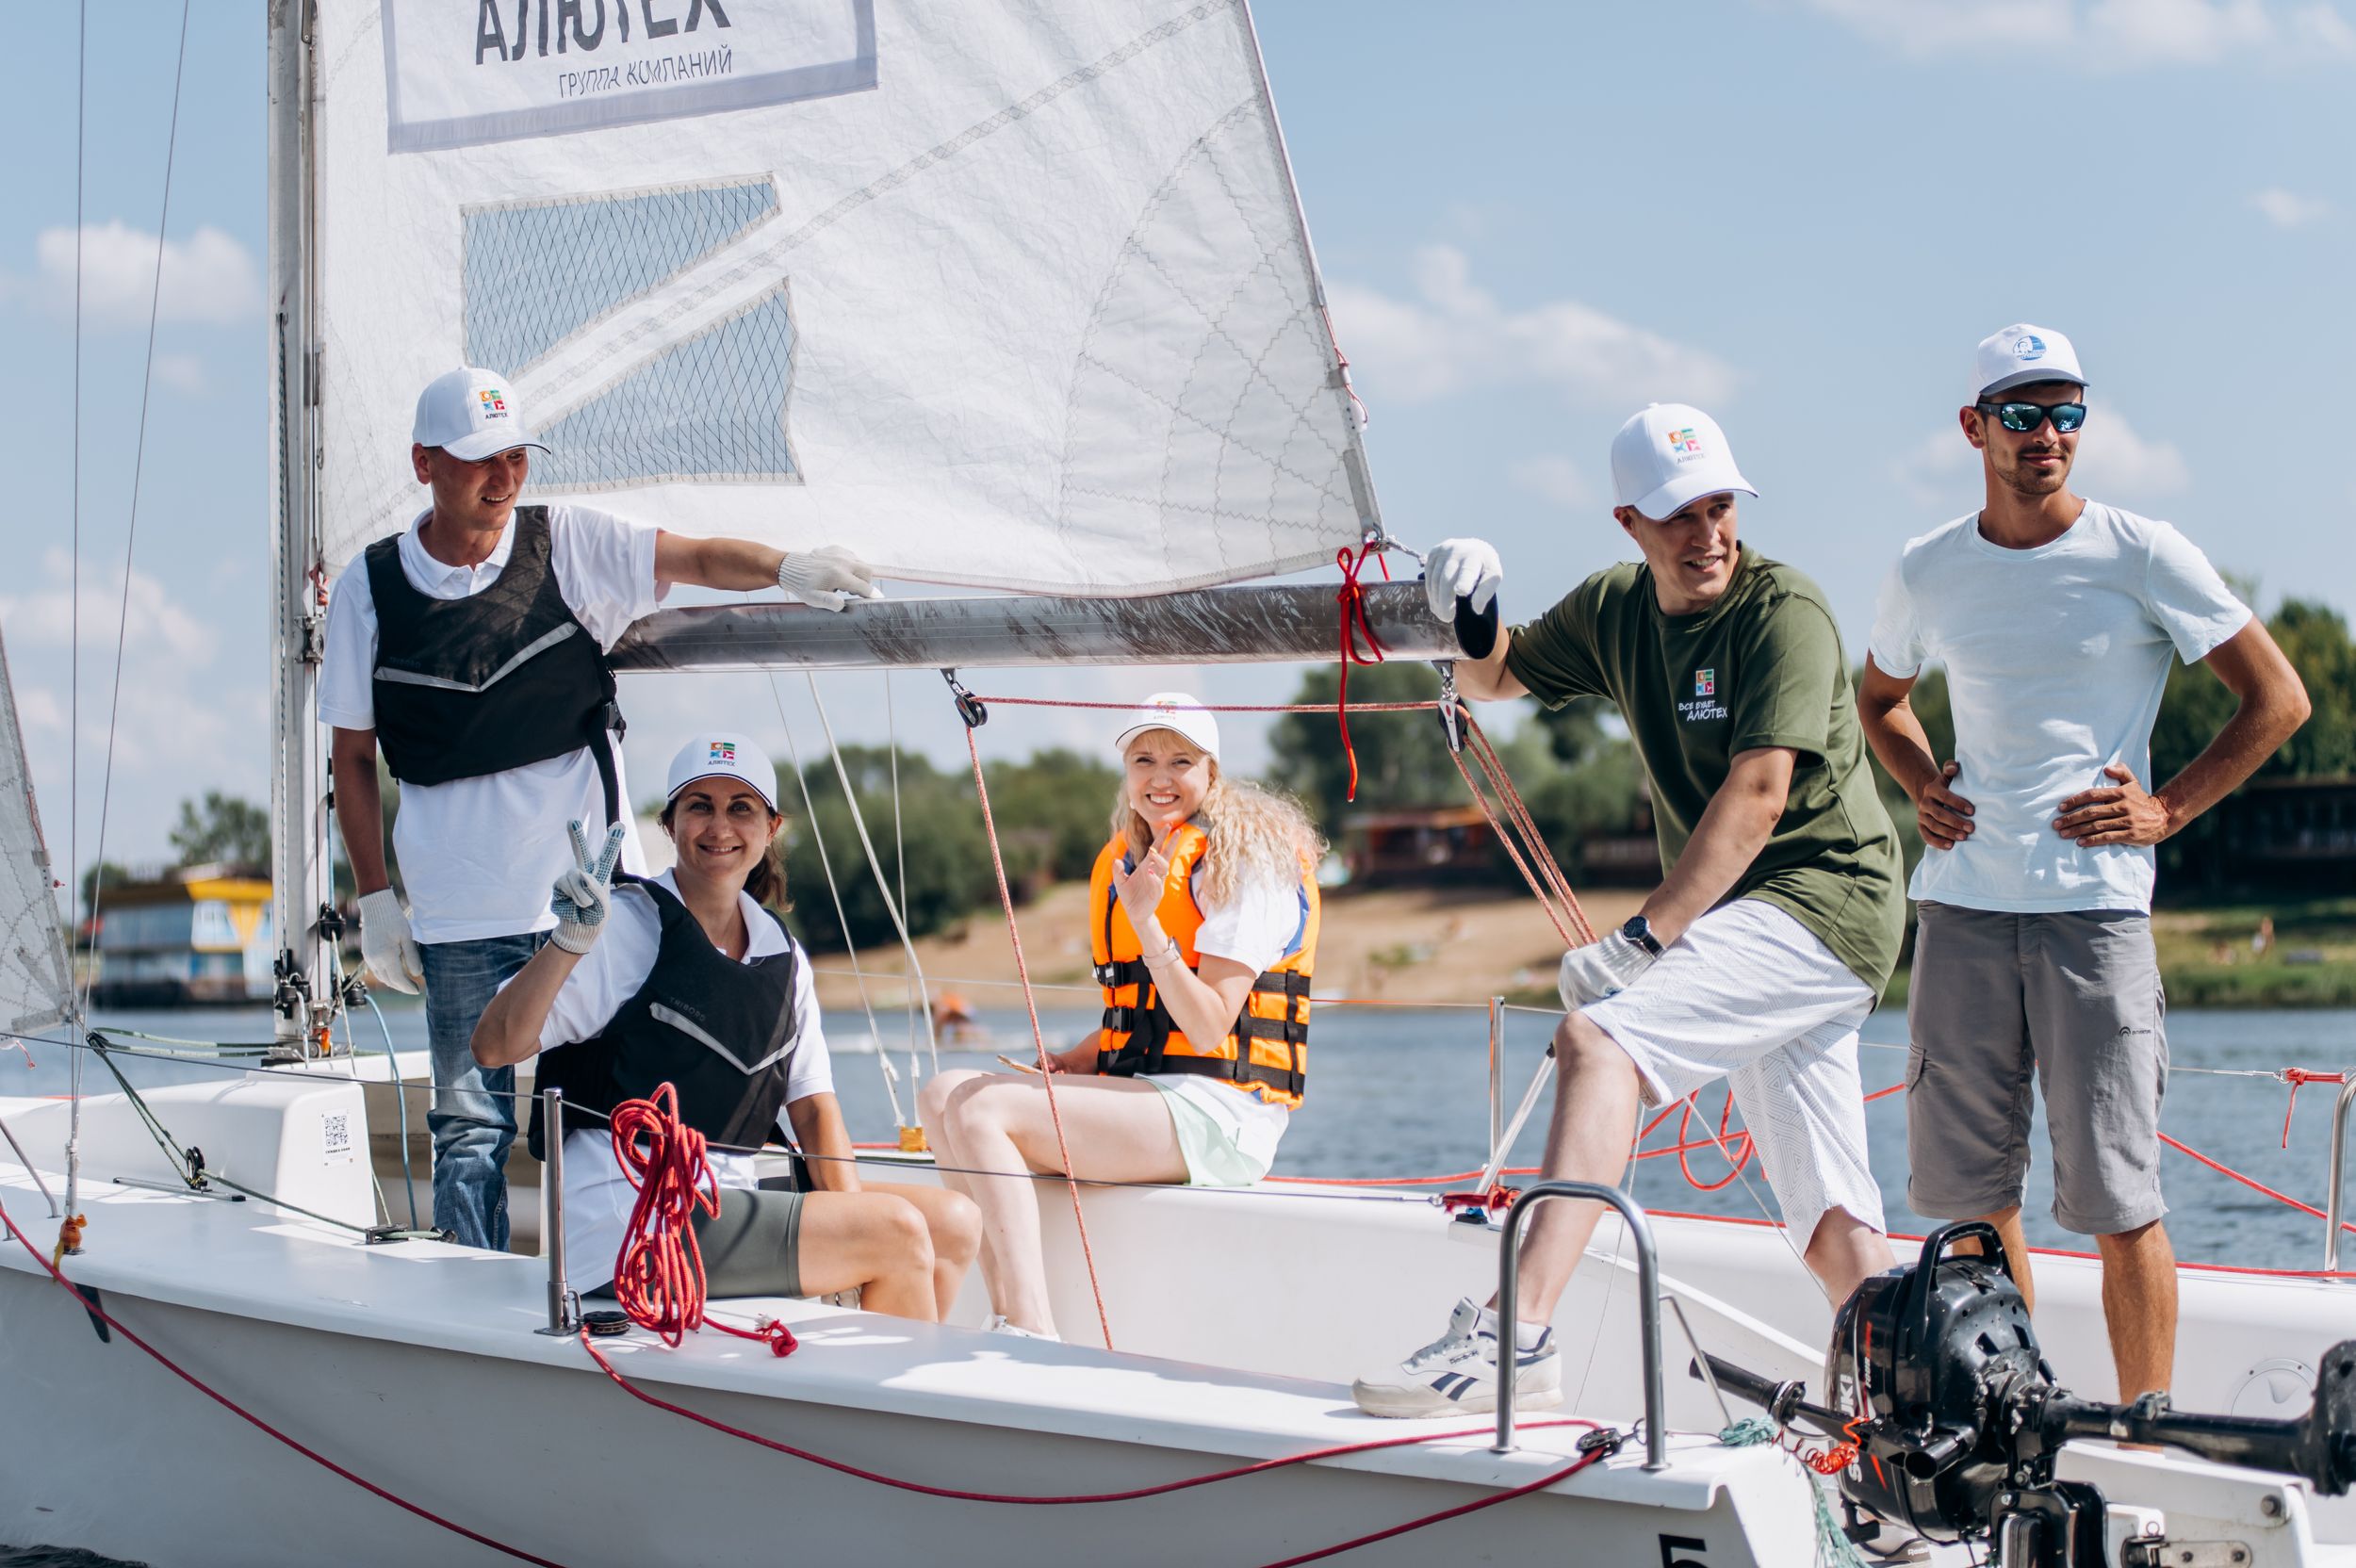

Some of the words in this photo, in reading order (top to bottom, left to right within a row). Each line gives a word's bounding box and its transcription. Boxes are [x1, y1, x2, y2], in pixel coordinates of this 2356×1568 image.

[559, 66, 621, 98] ГРУППА
[627, 44, 732, 86] КОМПАНИЙ
[1678, 702, 1694, 711] ВСЕ
[1695, 700, 1716, 710] БУДЕТ
[1687, 707, 1728, 722] АЛЮТЕХ
[1840, 1373, 1863, 1483] SUKI
